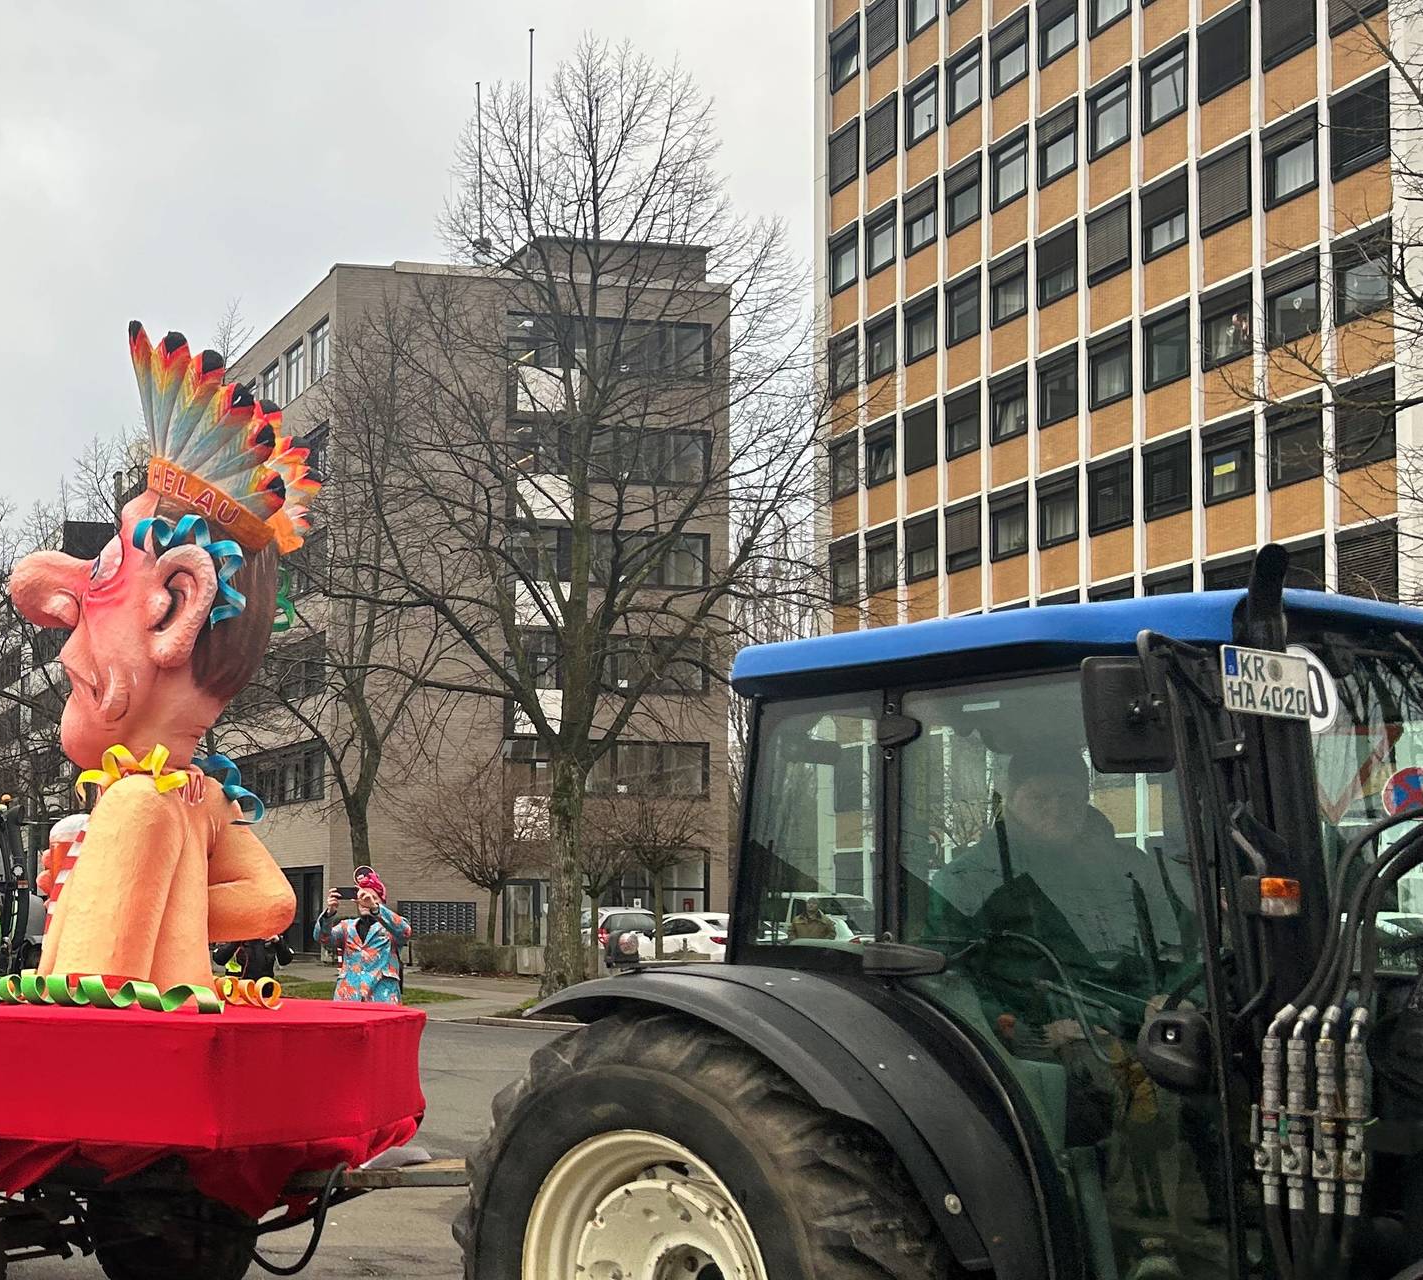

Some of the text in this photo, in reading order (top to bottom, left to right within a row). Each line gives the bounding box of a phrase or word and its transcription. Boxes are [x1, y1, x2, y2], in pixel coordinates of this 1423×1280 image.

[152, 463, 240, 525] HELAU
[1240, 653, 1266, 682] KR
[1227, 680, 1307, 716] HA 4020
